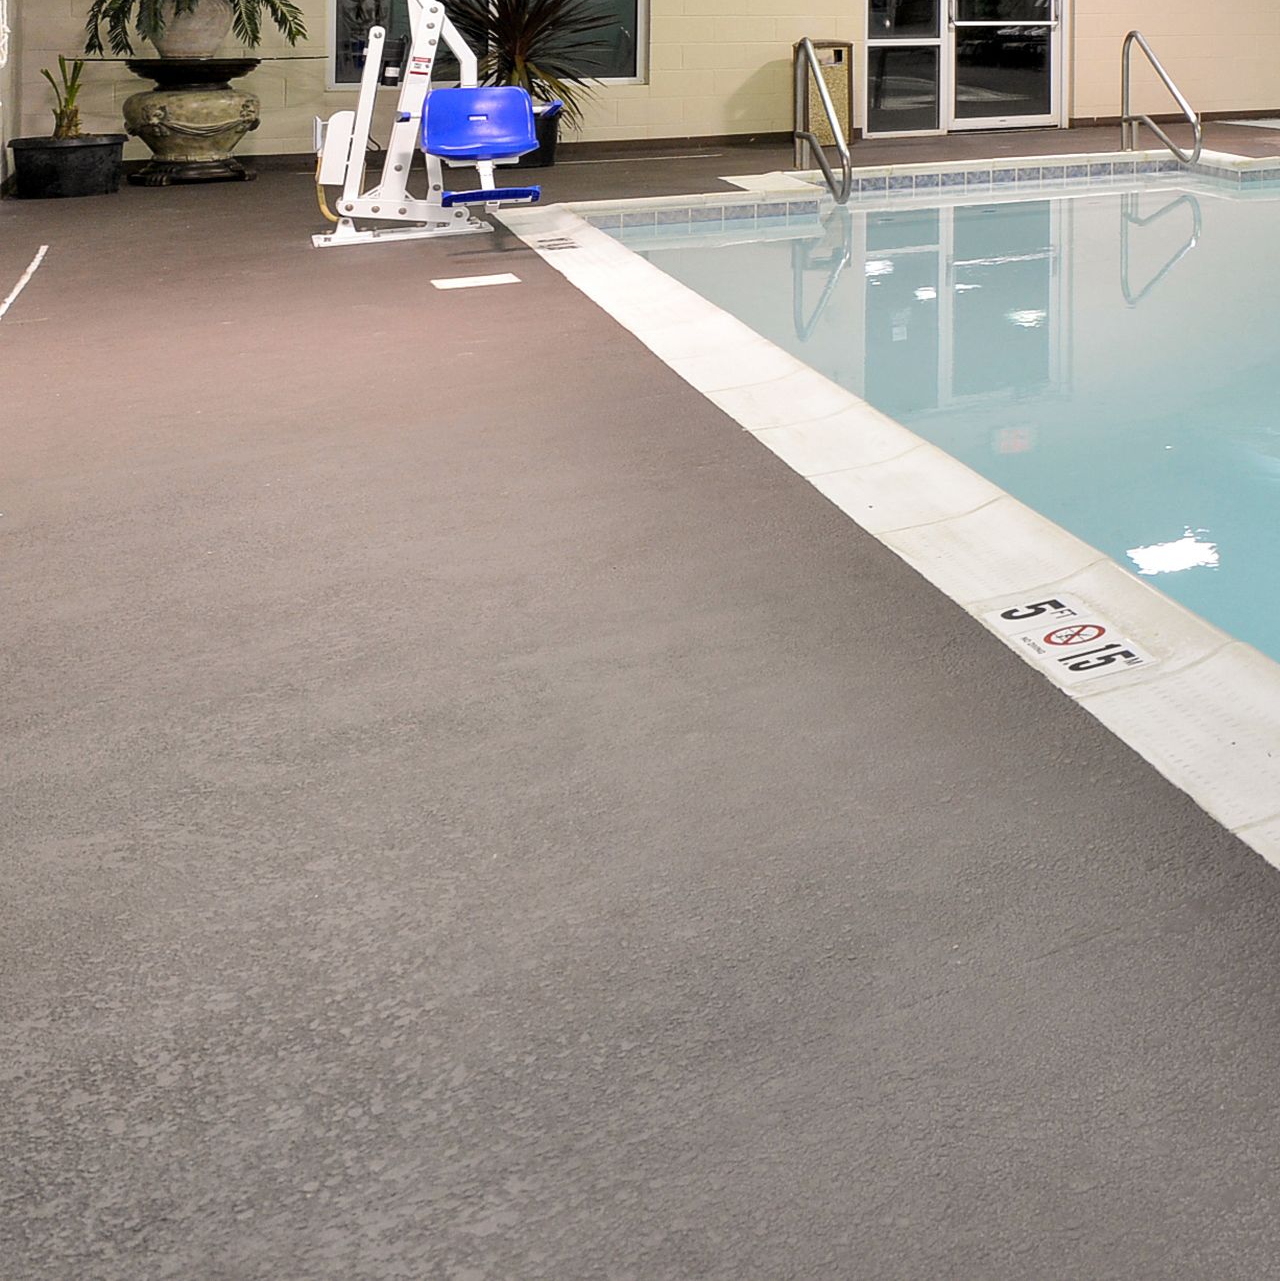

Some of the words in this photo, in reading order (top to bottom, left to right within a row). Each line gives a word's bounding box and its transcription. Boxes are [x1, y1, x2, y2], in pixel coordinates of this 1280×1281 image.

[1000, 599, 1066, 620] 5
[1049, 608, 1078, 620] FT
[1124, 656, 1143, 667] M
